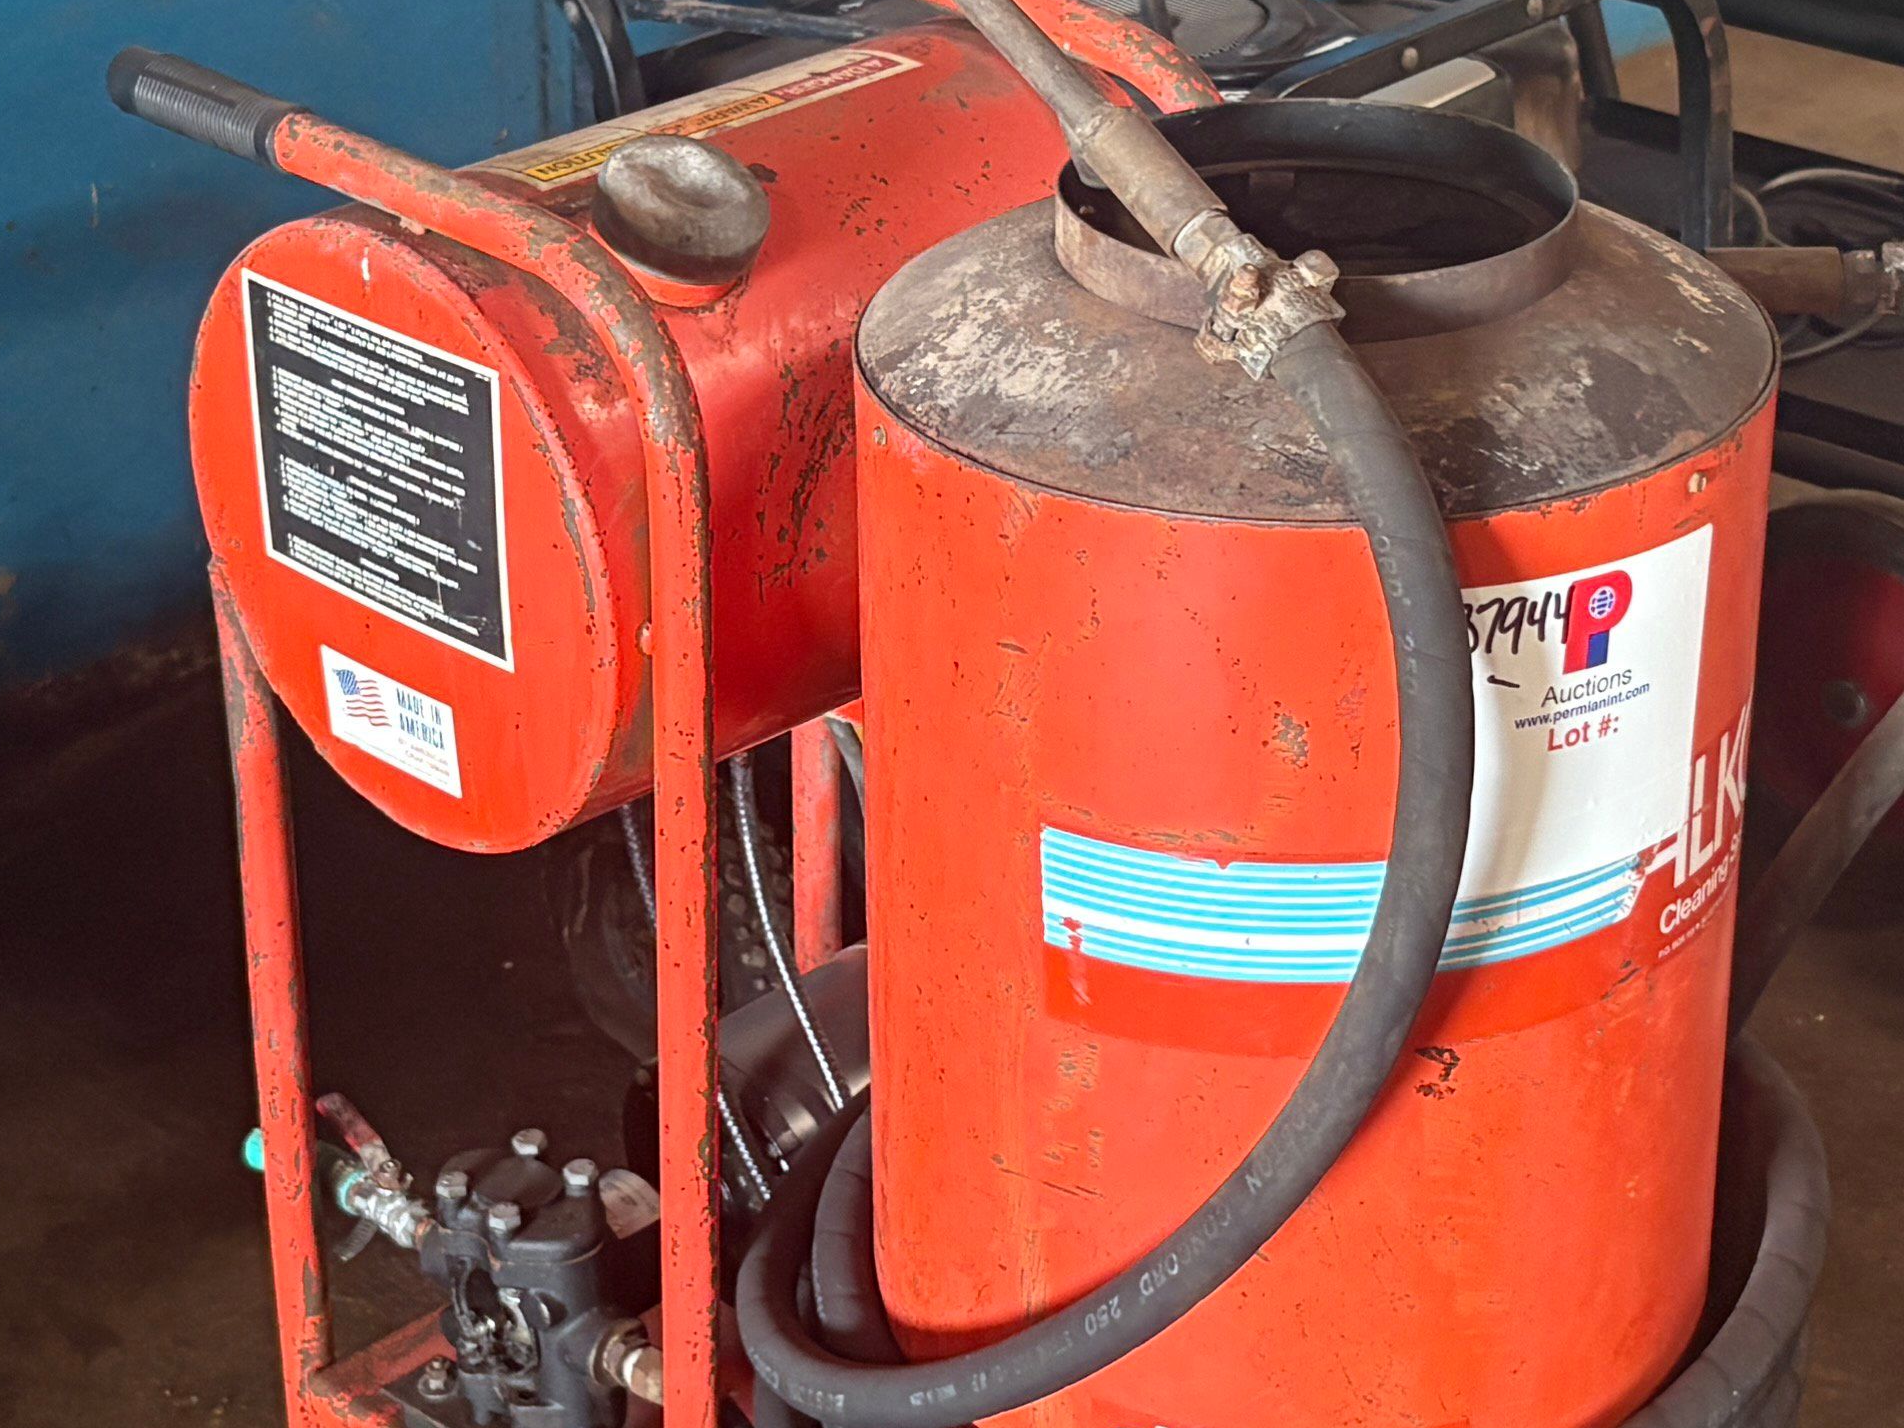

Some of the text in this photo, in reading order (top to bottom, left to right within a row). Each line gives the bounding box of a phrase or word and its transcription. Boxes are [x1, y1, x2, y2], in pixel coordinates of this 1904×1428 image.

[1514, 682, 1651, 730] www.permianint.com
[1540, 668, 1633, 708] Auctions
[1547, 713, 1620, 752] Lot #:
[1659, 860, 1729, 934] Cleaning
[1084, 1294, 1123, 1336] 250
